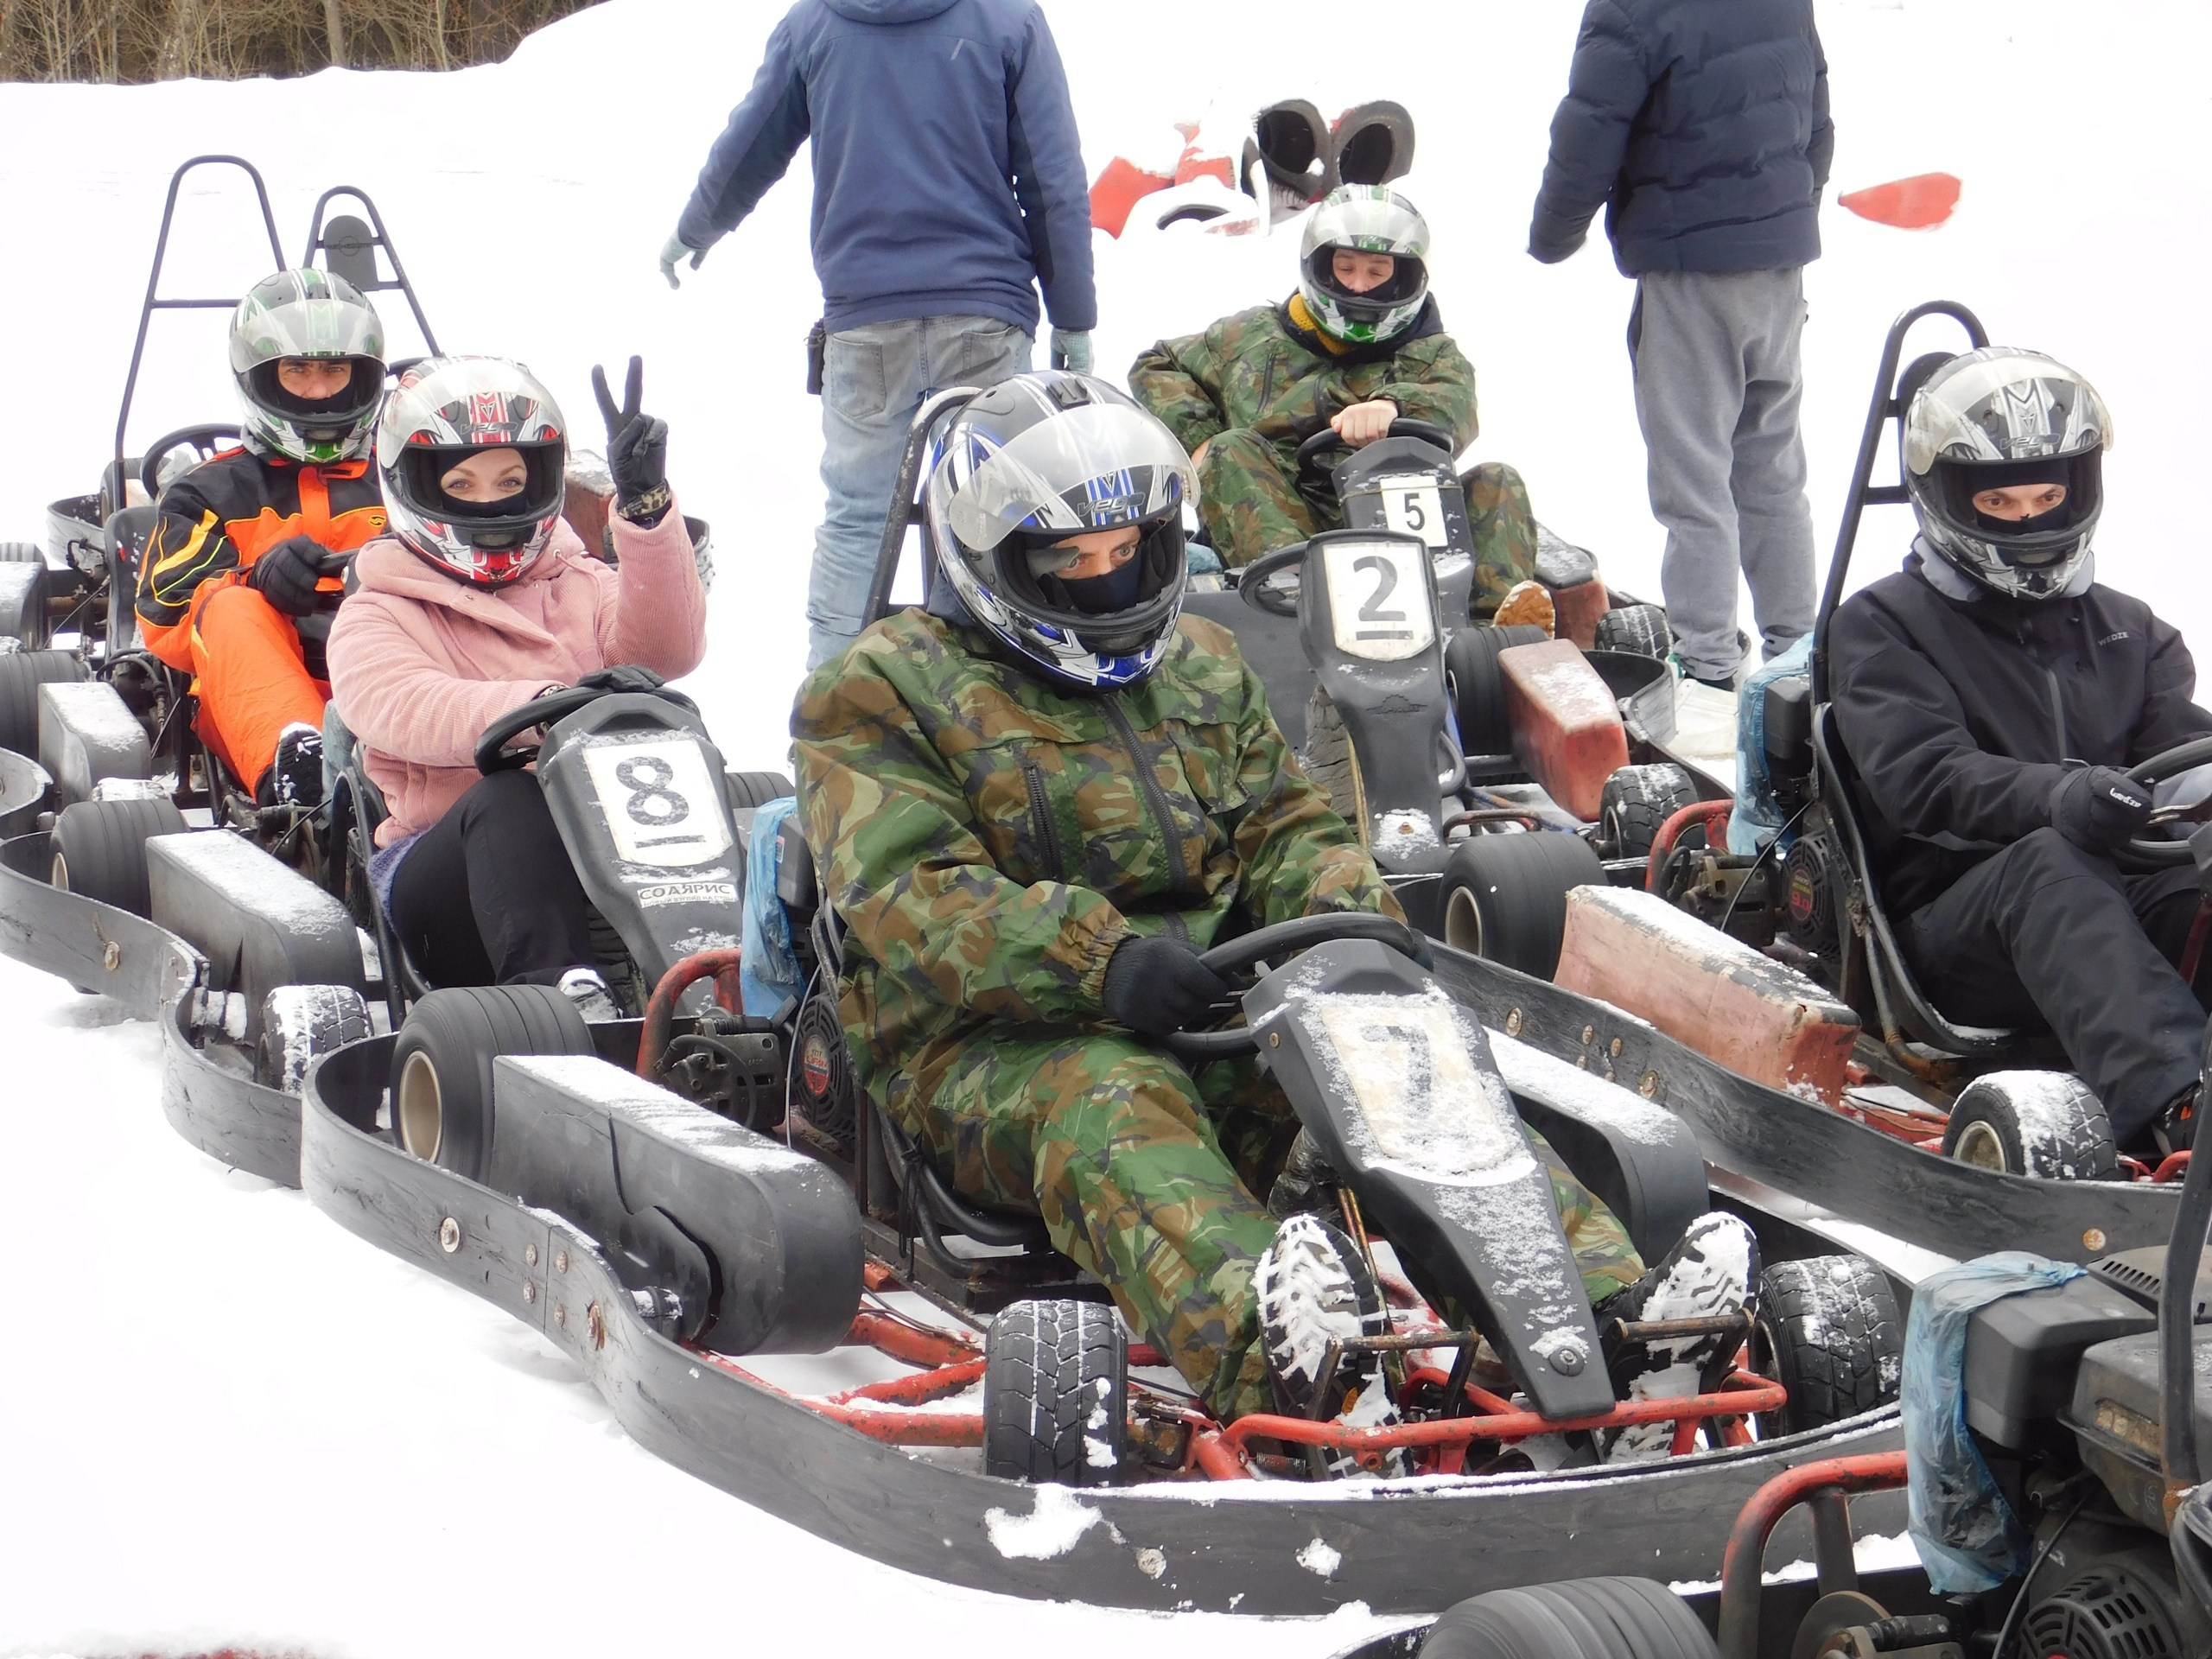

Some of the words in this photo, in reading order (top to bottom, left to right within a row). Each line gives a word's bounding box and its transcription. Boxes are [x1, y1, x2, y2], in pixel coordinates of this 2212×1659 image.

[1404, 493, 1426, 531] 5
[1353, 556, 1407, 622] 2
[615, 756, 690, 826] 8
